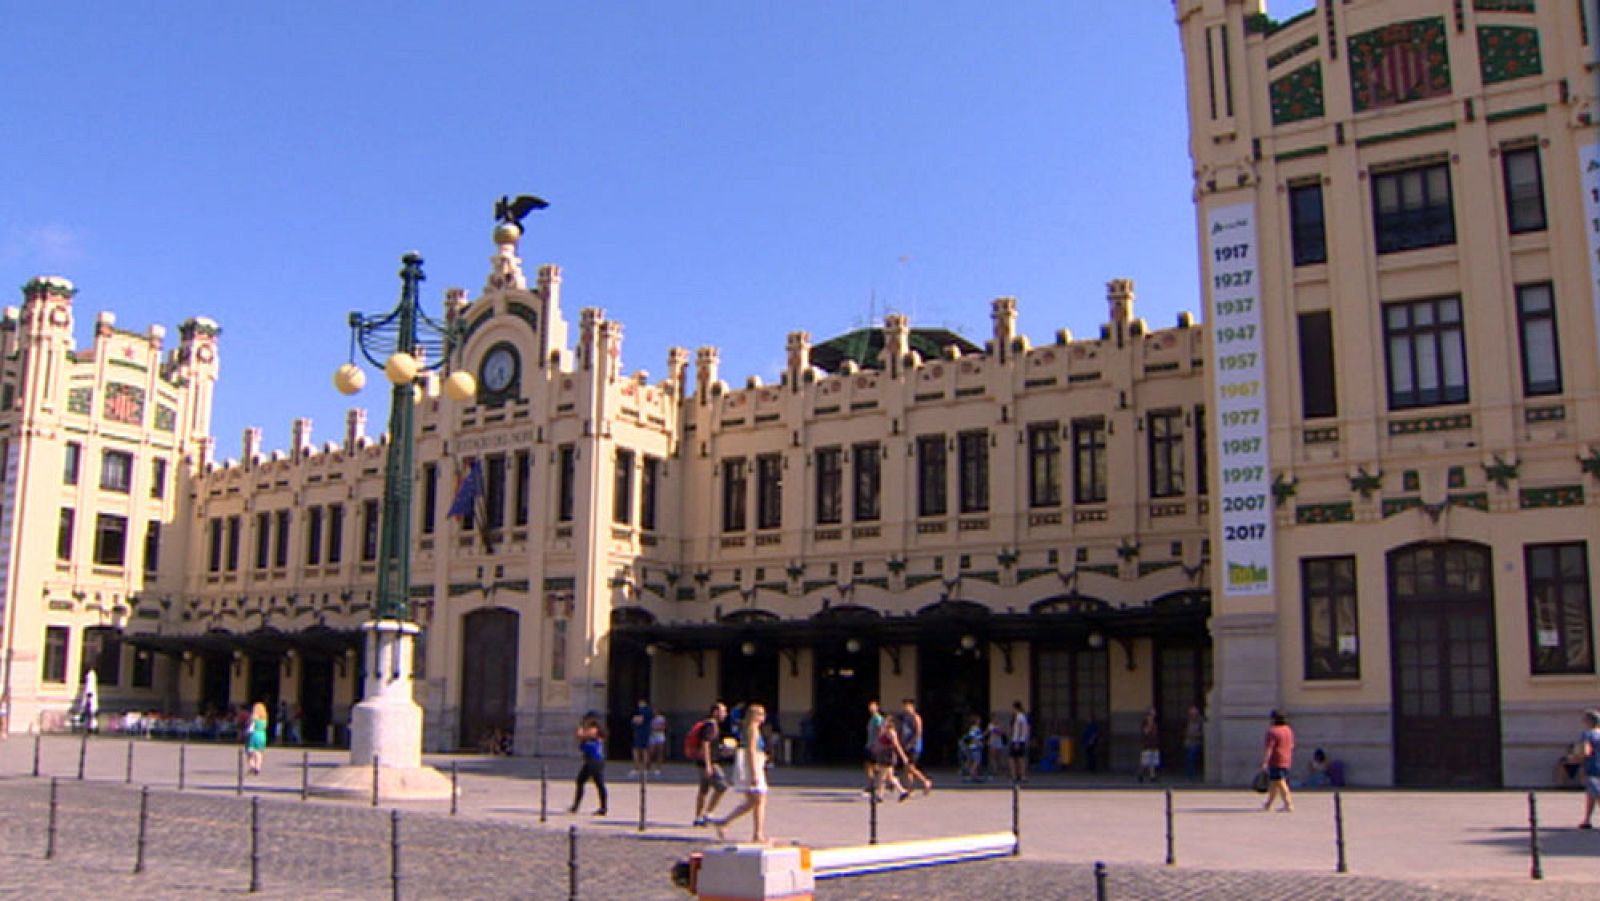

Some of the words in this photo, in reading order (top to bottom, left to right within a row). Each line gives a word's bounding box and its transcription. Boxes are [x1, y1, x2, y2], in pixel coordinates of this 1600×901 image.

[1214, 243, 1249, 262] 1917
[1214, 270, 1253, 290] 1927
[1216, 297, 1255, 316] 1937
[1216, 324, 1257, 344] 1947
[1218, 352, 1258, 371] 1957
[1221, 408, 1261, 427] 1977
[1222, 436, 1262, 455] 1987
[1222, 465, 1264, 484] 1997
[1223, 494, 1266, 513] 2007
[1225, 523, 1266, 541] 2017
